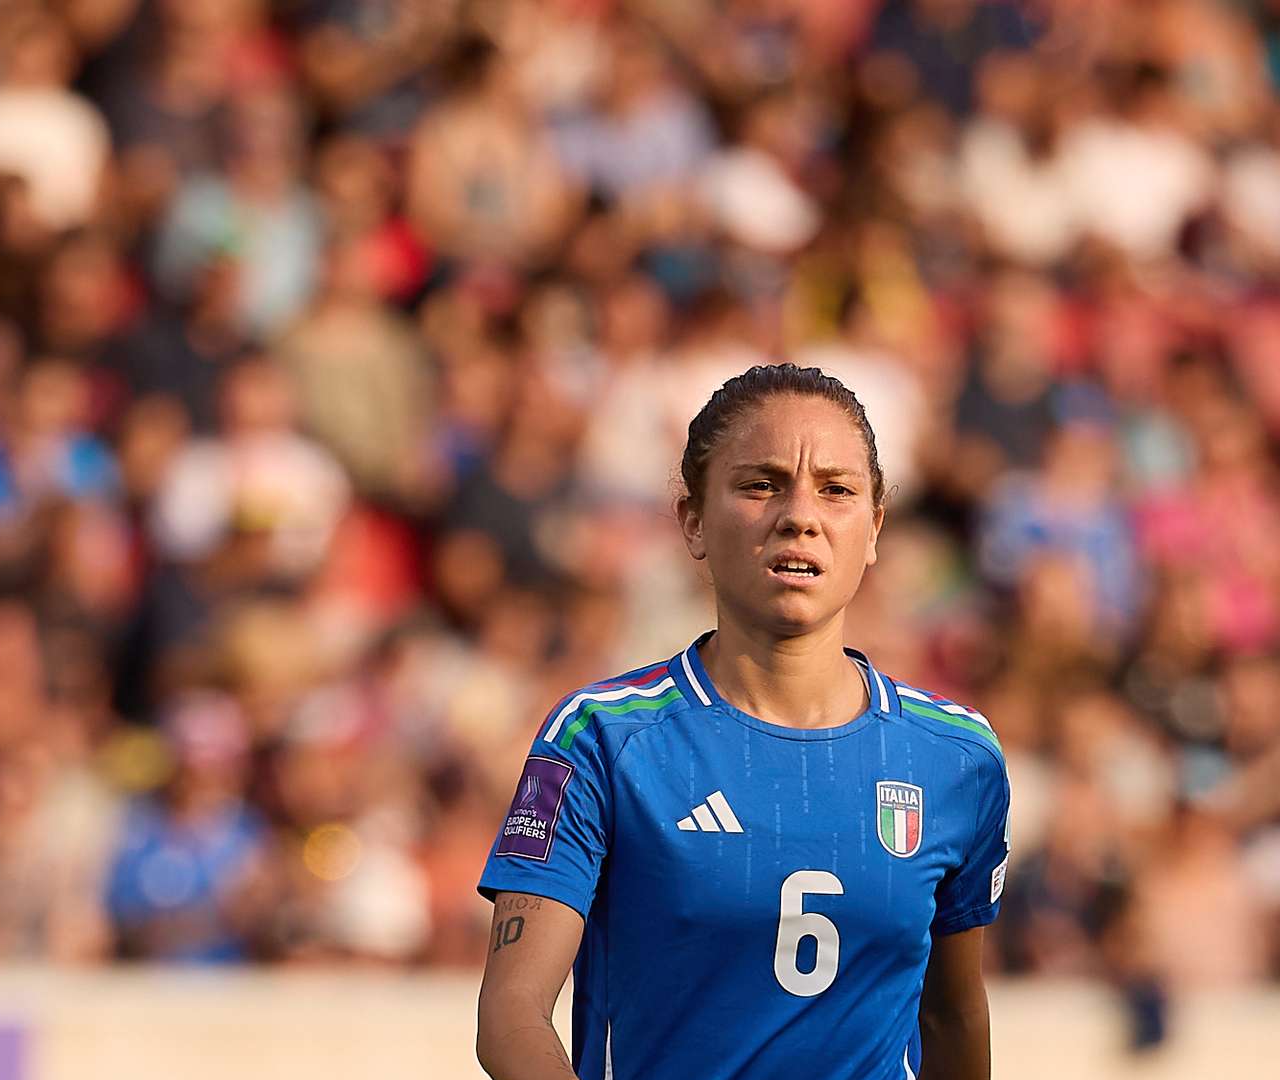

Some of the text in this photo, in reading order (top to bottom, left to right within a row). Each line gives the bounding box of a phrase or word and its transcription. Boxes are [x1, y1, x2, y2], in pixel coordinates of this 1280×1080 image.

[880, 786, 919, 805] ITALIA
[493, 915, 525, 953] 10
[774, 870, 844, 997] 6
